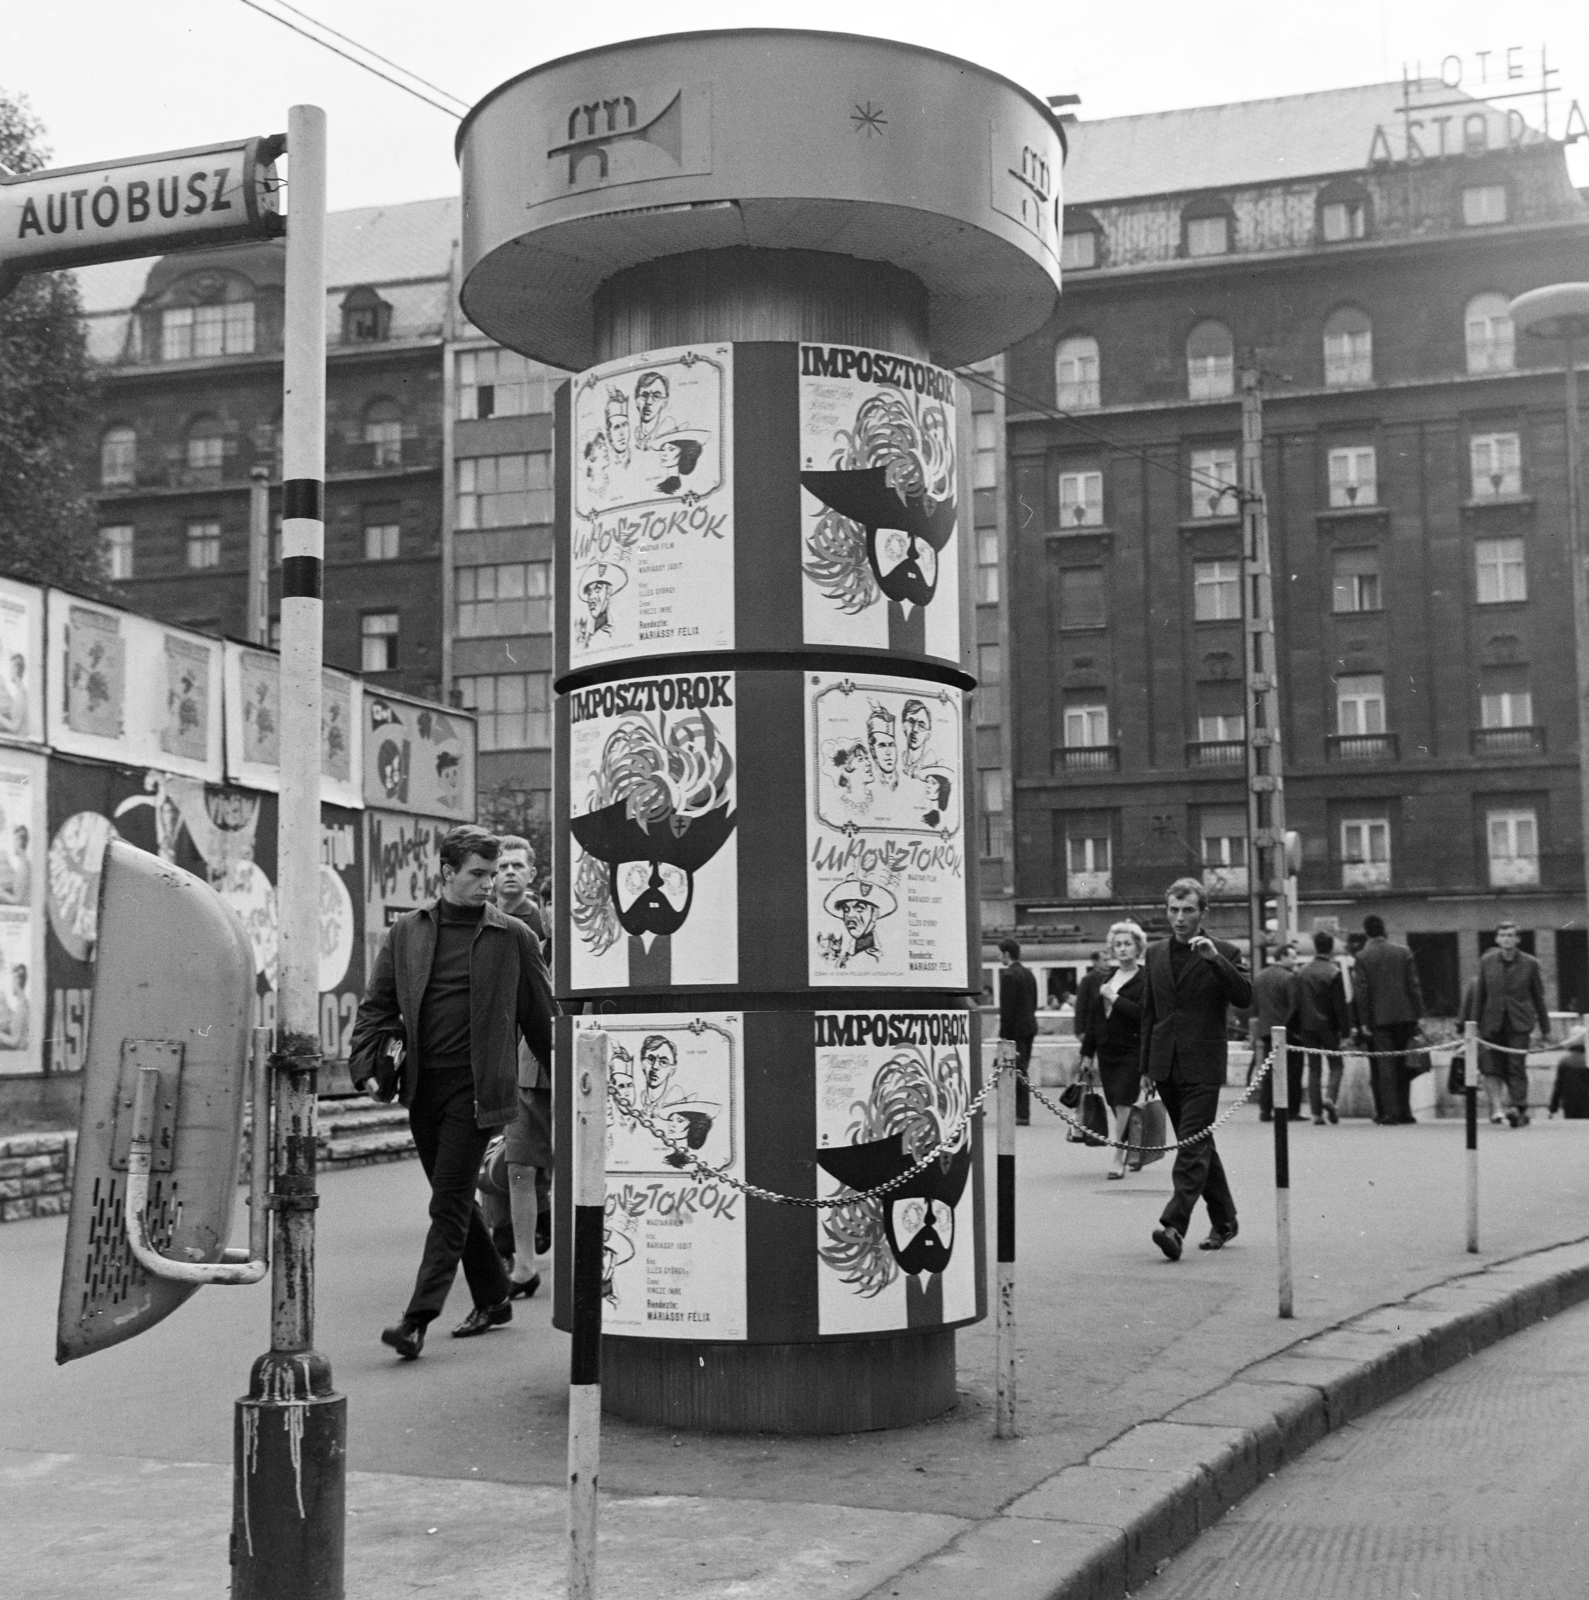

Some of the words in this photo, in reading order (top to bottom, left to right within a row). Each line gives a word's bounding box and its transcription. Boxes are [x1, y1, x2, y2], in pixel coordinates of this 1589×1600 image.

[1403, 43, 1559, 95] HOTEL
[18, 168, 231, 238] AUTÓBUSZ
[801, 346, 955, 407] IMPOSZTOROK
[574, 505, 728, 560] IMPOSZTOROK
[572, 675, 733, 724] IMPOSZTOROK
[811, 836, 963, 878] IMPOSZTOROK
[815, 1014, 968, 1047] IMPOSZTOROK
[604, 1183, 739, 1221] OSZTOROK
